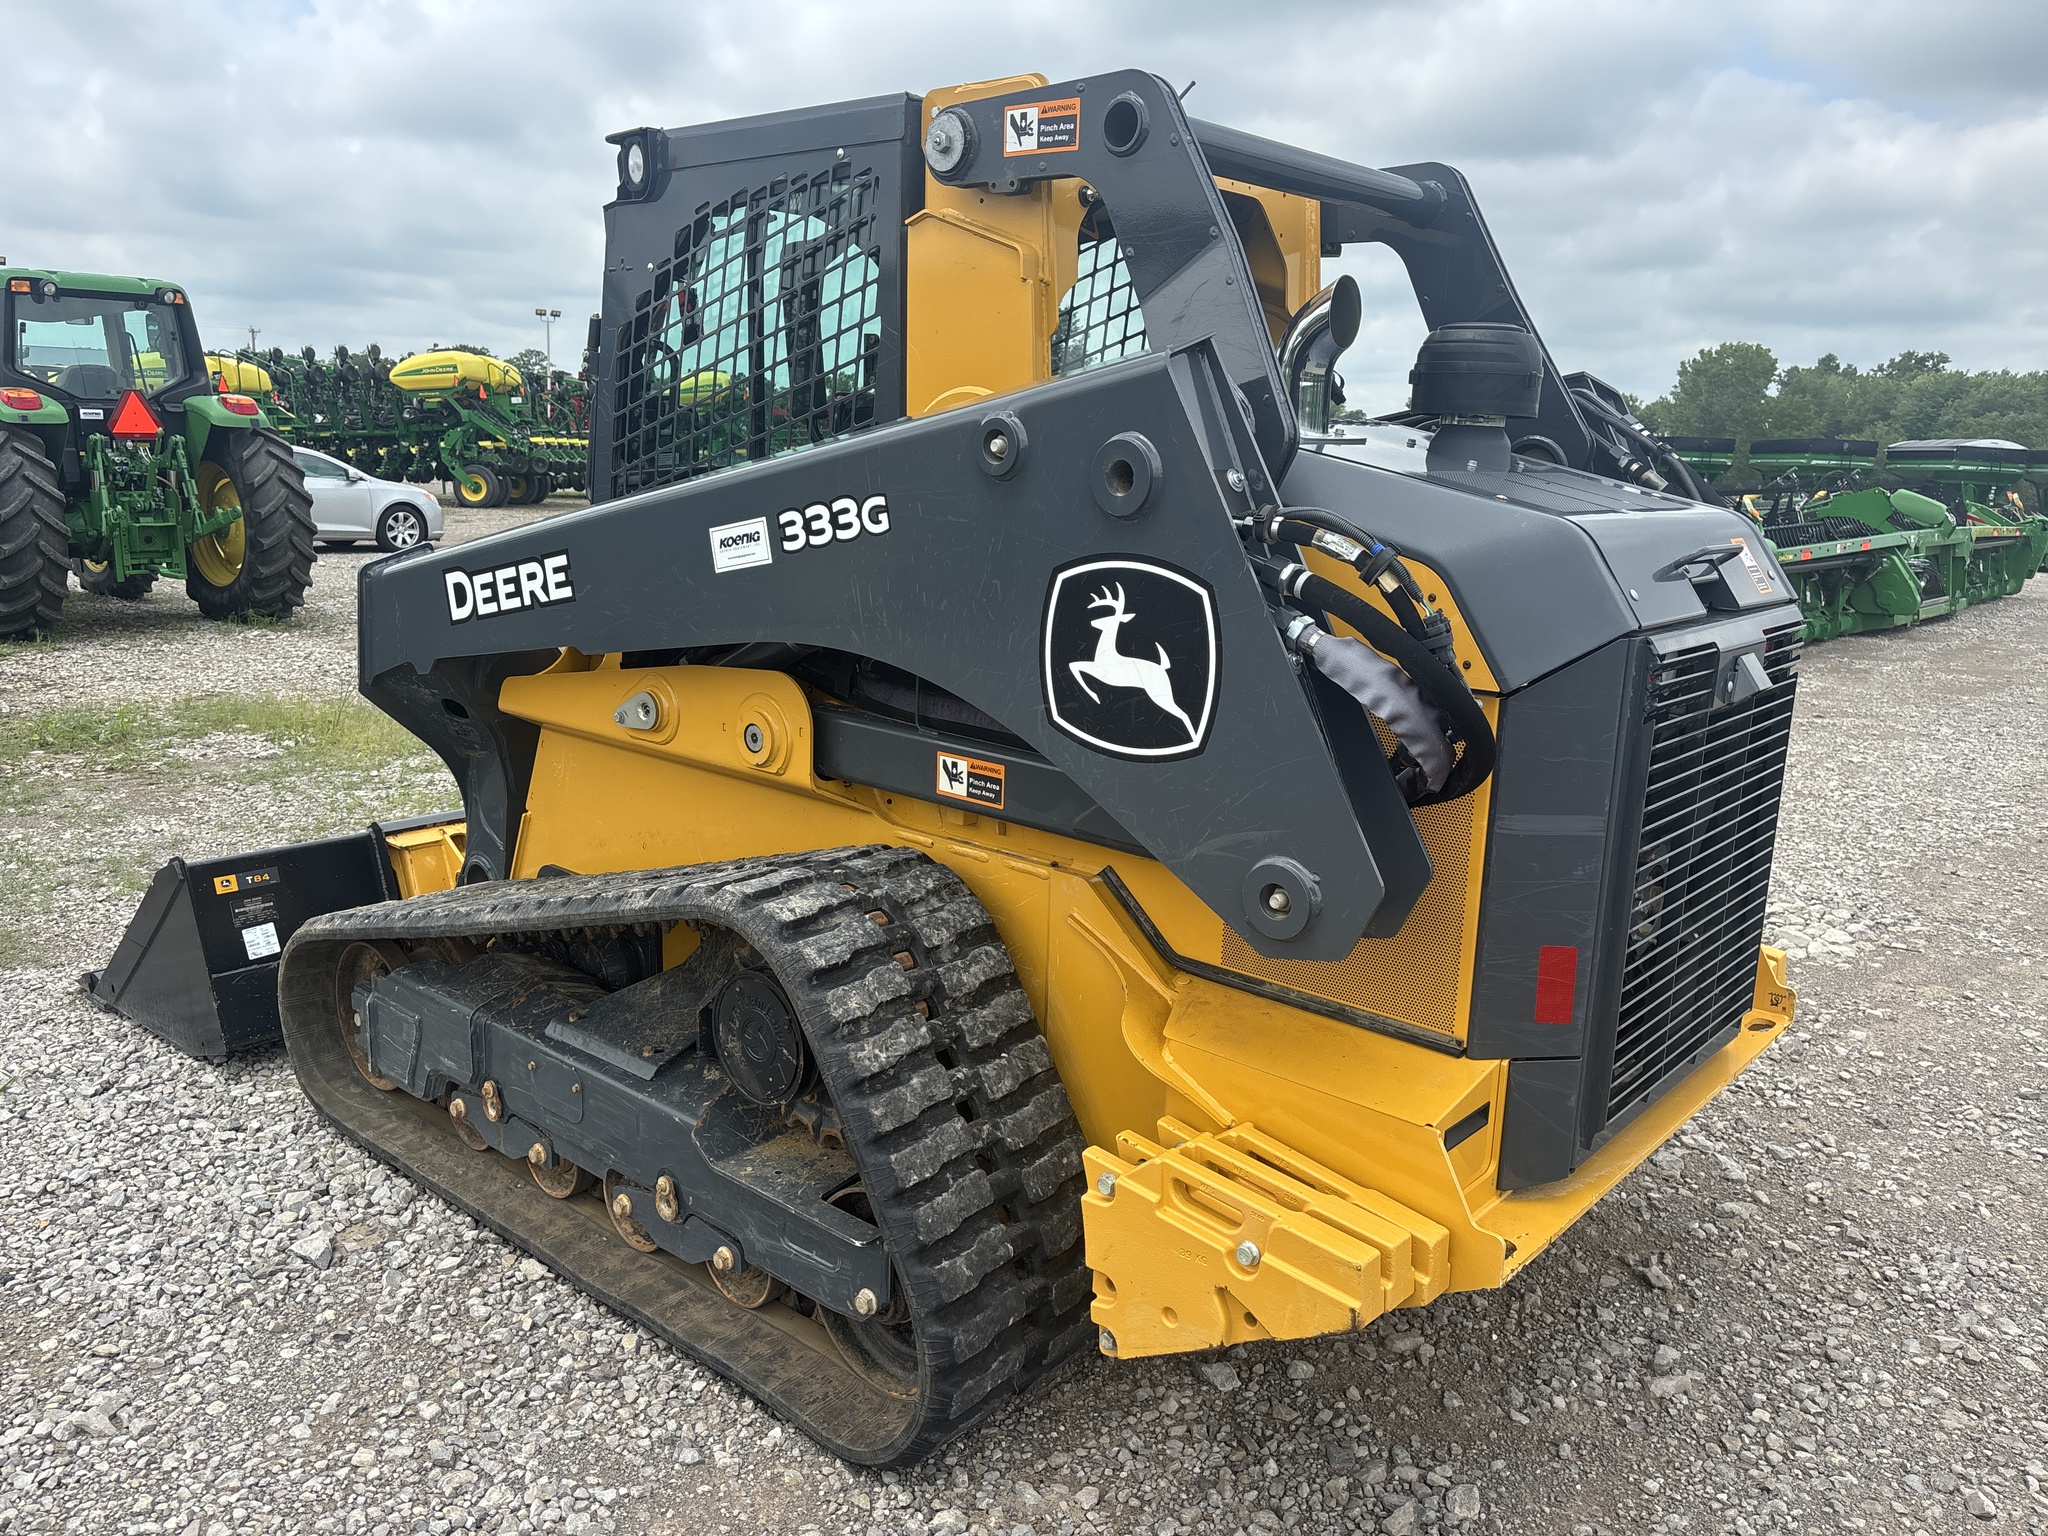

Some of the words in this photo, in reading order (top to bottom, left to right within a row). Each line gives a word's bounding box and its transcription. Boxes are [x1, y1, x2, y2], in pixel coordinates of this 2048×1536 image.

[1047, 103, 1076, 113] WARNING
[1040, 123, 1058, 132] Pinch
[1059, 122, 1074, 131] Area
[1054, 134, 1069, 142] Away
[779, 495, 890, 552] 333G
[445, 554, 573, 621] DEERE
[974, 763, 1002, 775] WARNING
[969, 777, 986, 787] Pinch
[986, 781, 1000, 791] Area
[969, 787, 981, 796] Keep
[982, 789, 995, 799] Away
[245, 873, 271, 884] T84
[1195, 1254, 1208, 1266] KG
